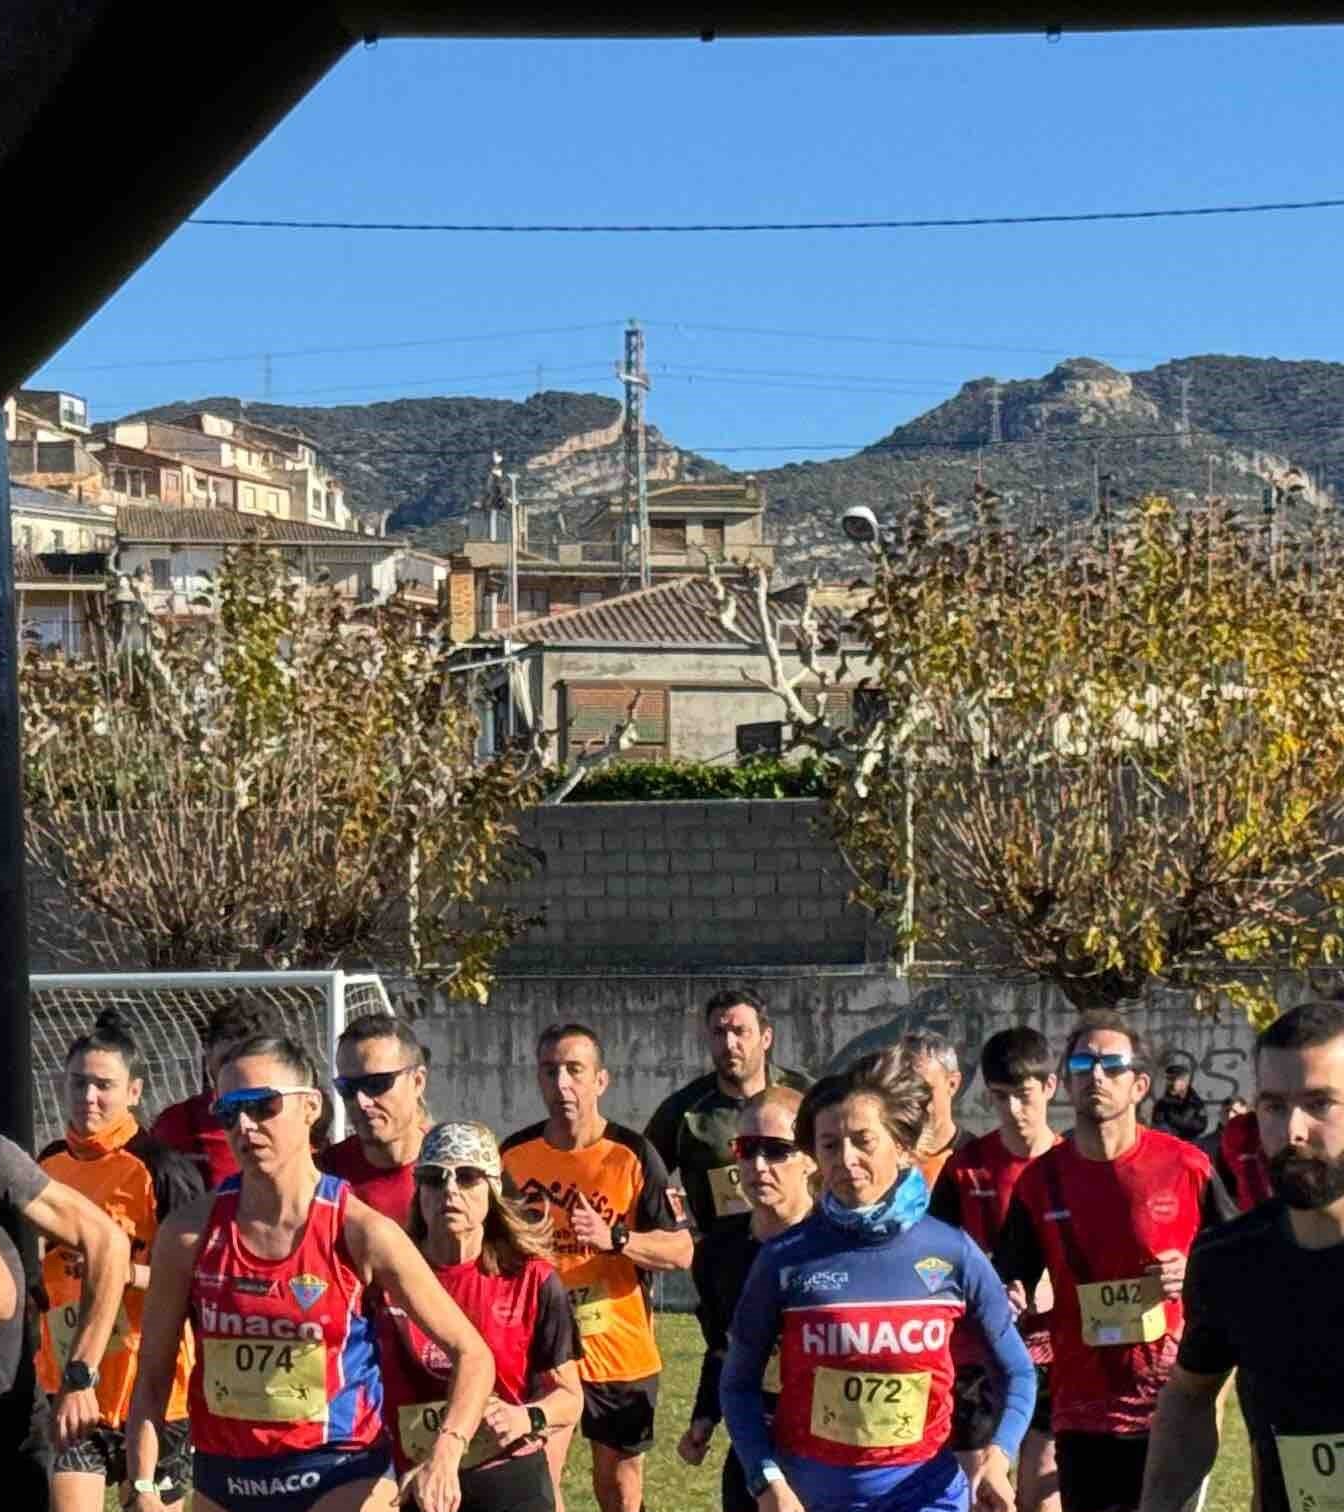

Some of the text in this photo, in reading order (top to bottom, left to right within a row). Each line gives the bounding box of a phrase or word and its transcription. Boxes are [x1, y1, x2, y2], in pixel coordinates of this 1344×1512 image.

[1100, 1283, 1143, 1307] 042
[235, 1343, 294, 1374] 074
[844, 1376, 903, 1403] 072
